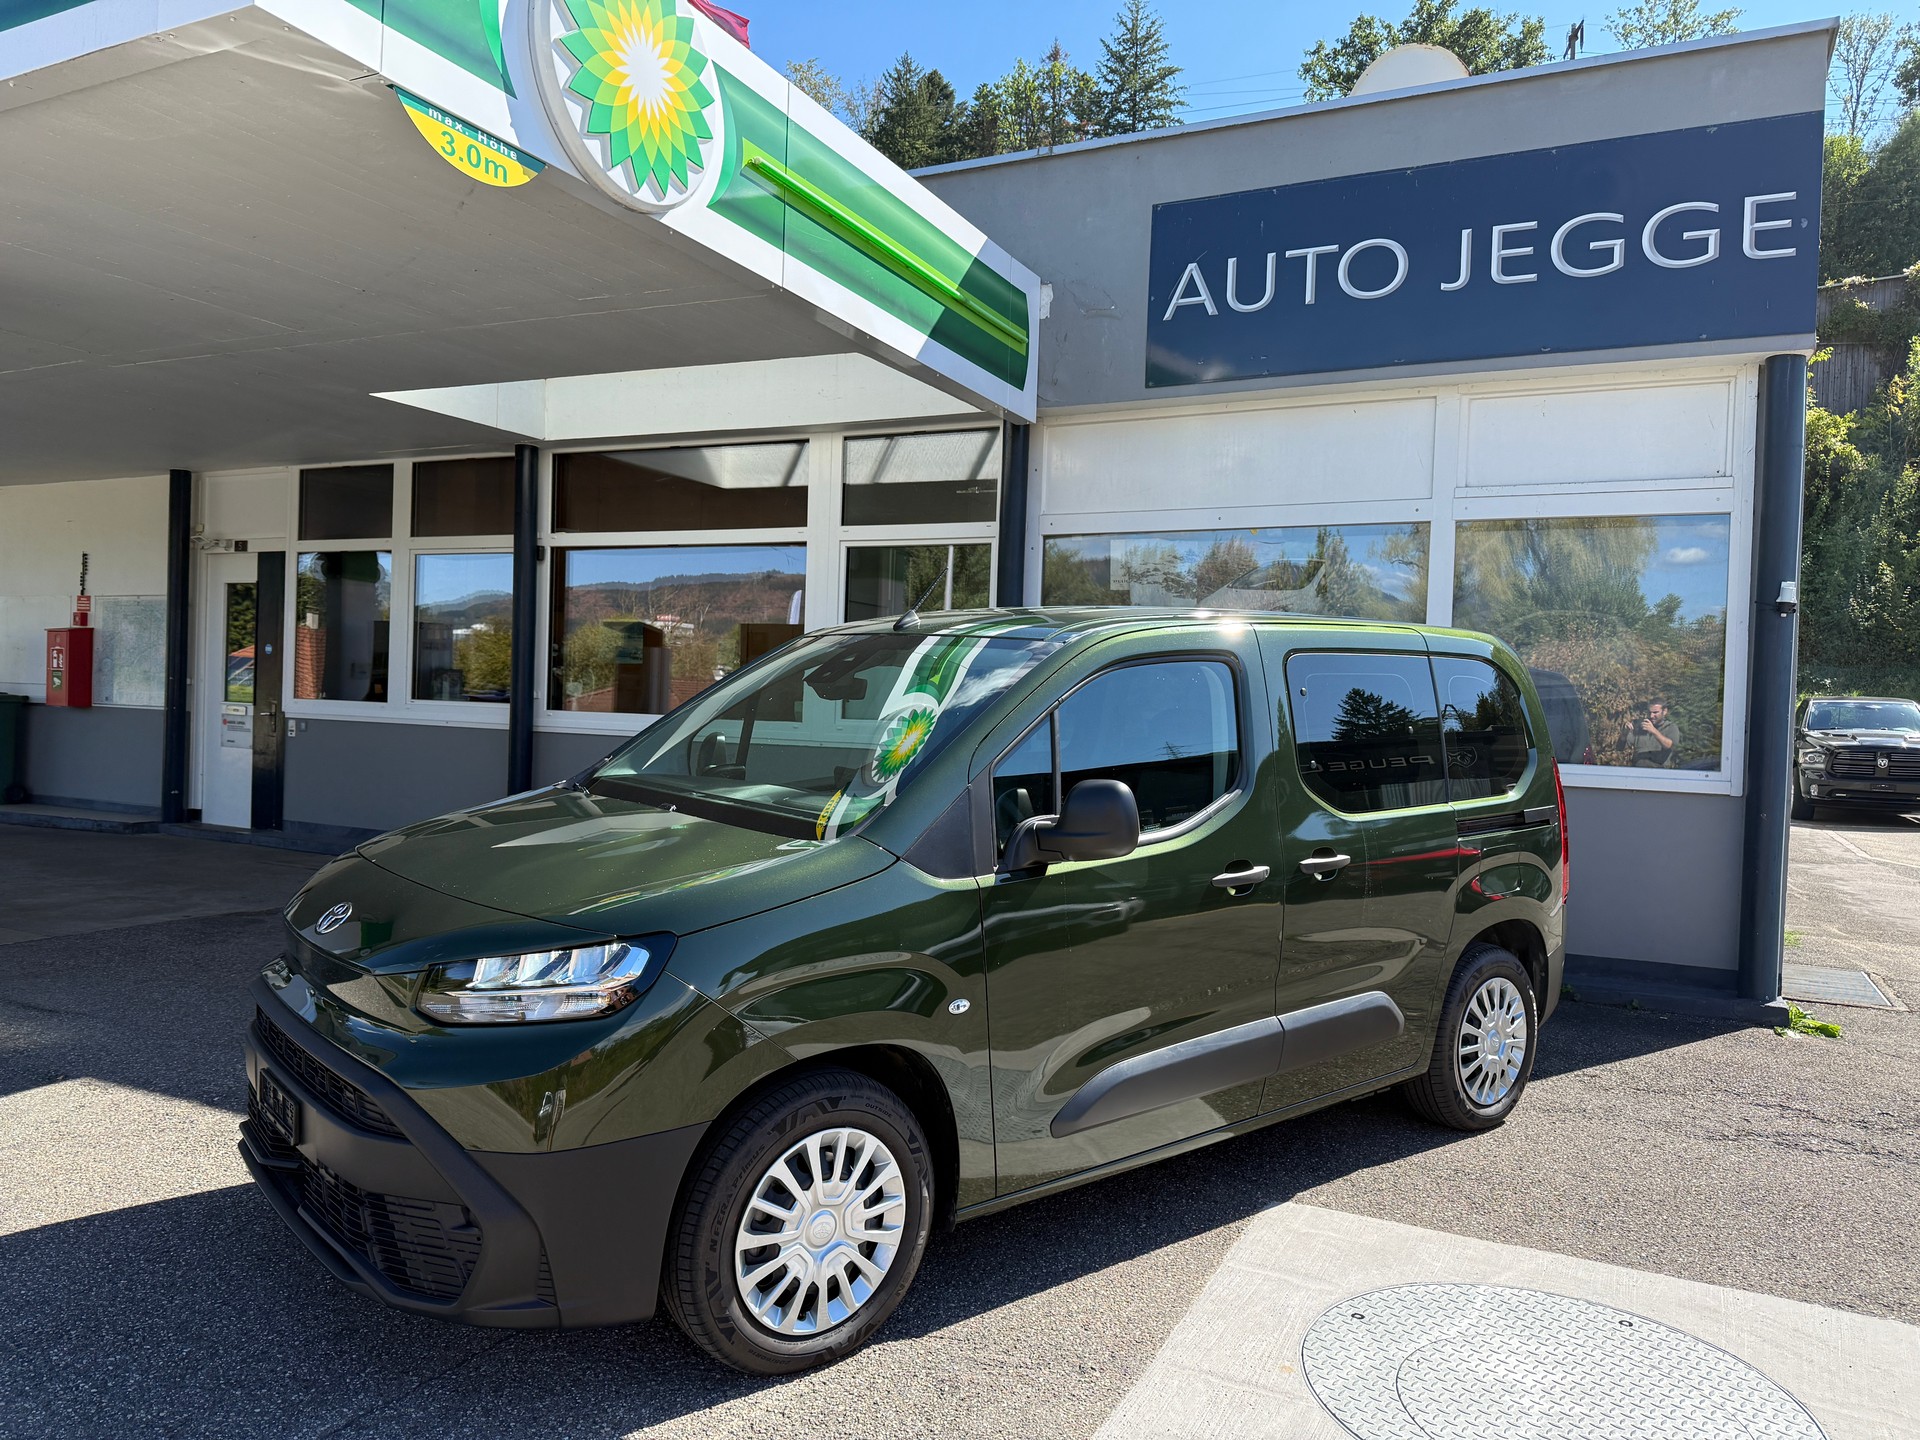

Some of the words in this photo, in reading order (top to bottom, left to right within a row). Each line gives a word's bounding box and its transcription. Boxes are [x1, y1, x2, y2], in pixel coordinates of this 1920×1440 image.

[428, 107, 469, 136] max.
[477, 131, 518, 160] Höhe
[440, 130, 508, 184] 3.0m
[1162, 237, 1410, 321] AUTO
[1440, 191, 1798, 291] JEGGE
[864, 1102, 893, 1118] OUTSIDE
[732, 1143, 766, 1189] Primus
